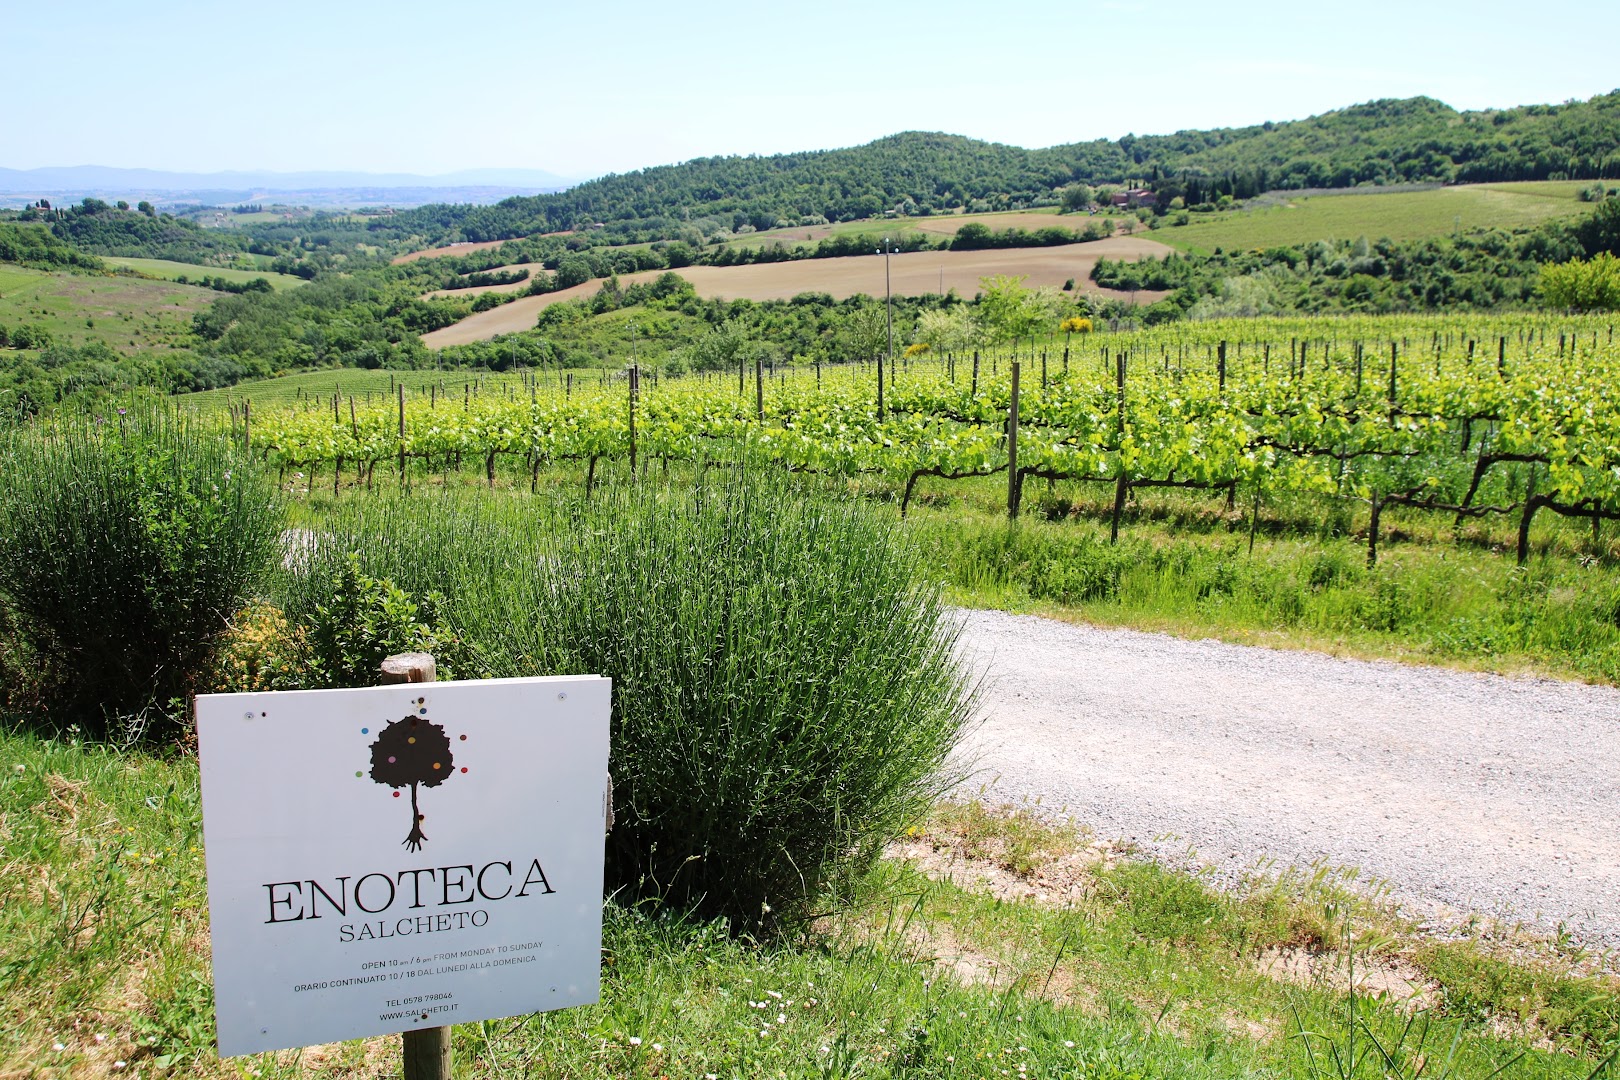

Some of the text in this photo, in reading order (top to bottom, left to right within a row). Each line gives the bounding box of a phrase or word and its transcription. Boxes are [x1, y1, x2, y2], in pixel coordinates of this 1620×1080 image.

[262, 858, 556, 924] ENOTECA
[340, 910, 489, 943] SALCHETO
[361, 961, 386, 970] OPEN
[388, 959, 398, 967] 10
[416, 956, 421, 964] 6
[433, 952, 458, 961] FROM
[460, 947, 496, 958] MONDAY
[497, 945, 508, 953] TO
[509, 941, 543, 952] SUNDAY
[294, 981, 328, 993] ORARIO
[329, 974, 387, 988] CONTINUATO
[389, 972, 399, 980] 10
[406, 970, 416, 978] 18
[417, 968, 435, 977] DAL
[436, 963, 468, 974] LUNEDI
[469, 961, 491, 970] ALLA
[493, 955, 537, 967] DOMENICA
[379, 1003, 459, 1021] WWW.SALCHETO.IT
[385, 991, 453, 1007] TEL 0578 798046
